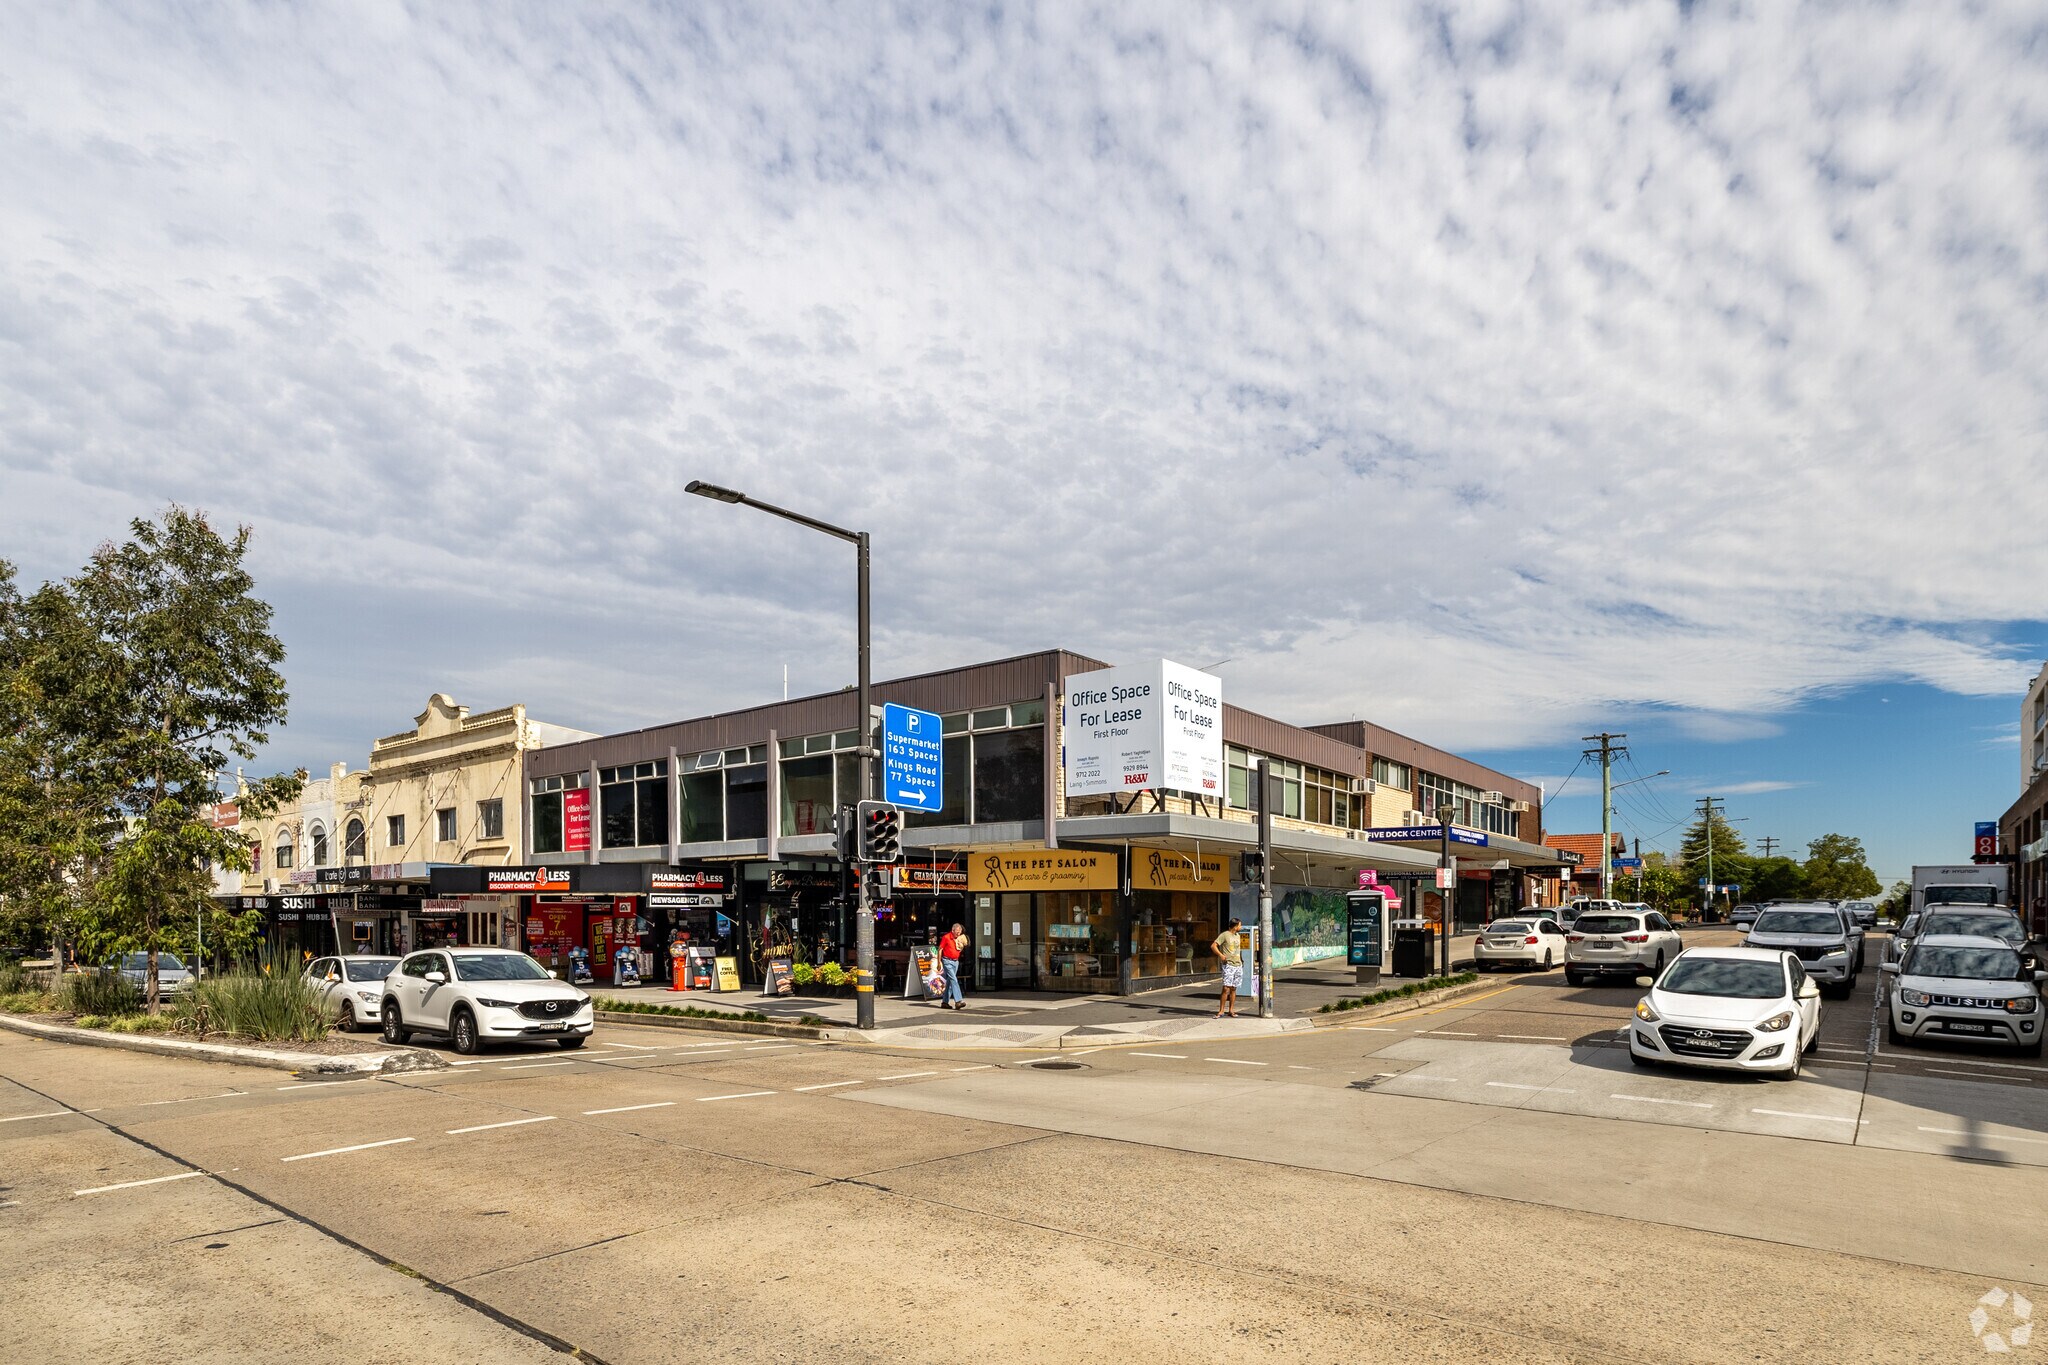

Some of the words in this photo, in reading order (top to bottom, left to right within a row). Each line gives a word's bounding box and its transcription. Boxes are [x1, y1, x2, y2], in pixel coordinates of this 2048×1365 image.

[1072, 691, 1107, 707] Office
[1112, 685, 1150, 703] Space
[1168, 681, 1191, 700] Office
[1195, 690, 1216, 708] Space
[909, 715, 918, 730] P
[1081, 714, 1100, 727] For
[1105, 709, 1141, 724] Lease
[1174, 705, 1187, 721] For
[1190, 709, 1212, 728] Lease
[1094, 730, 1108, 739] First
[1111, 728, 1128, 737] Floor
[1184, 727, 1193, 736] First
[1195, 730, 1205, 739] Floor
[888, 732, 939, 750] Supermarket
[888, 744, 904, 755] 163
[909, 748, 938, 761] Spaces
[888, 759, 912, 772] Kings
[916, 764, 936, 775] Road
[891, 772, 902, 781] 77
[906, 775, 935, 787] Spaces
[1124, 773, 1148, 784] R&W
[568, 805, 580, 813] Office
[1386, 830, 1408, 838] DOCK
[1005, 861, 1026, 869] THE
[1032, 860, 1052, 868] PET
[1058, 858, 1096, 867] SALON
[1164, 859, 1179, 868] THE
[349, 870, 360, 878] cafe
[489, 871, 536, 881] PHARMACY
[536, 867, 547, 886] 4
[548, 871, 570, 881] LESS
[652, 874, 695, 882] PHARMACY
[696, 872, 705, 885] 4
[944, 874, 967, 882] CHICKEN
[1012, 874, 1023, 884] pet
[1042, 871, 1048, 880] &
[1050, 872, 1086, 882] grooming
[282, 898, 315, 909] SUSHI
[328, 898, 348, 908] HUB
[554, 920, 560, 930] 7
